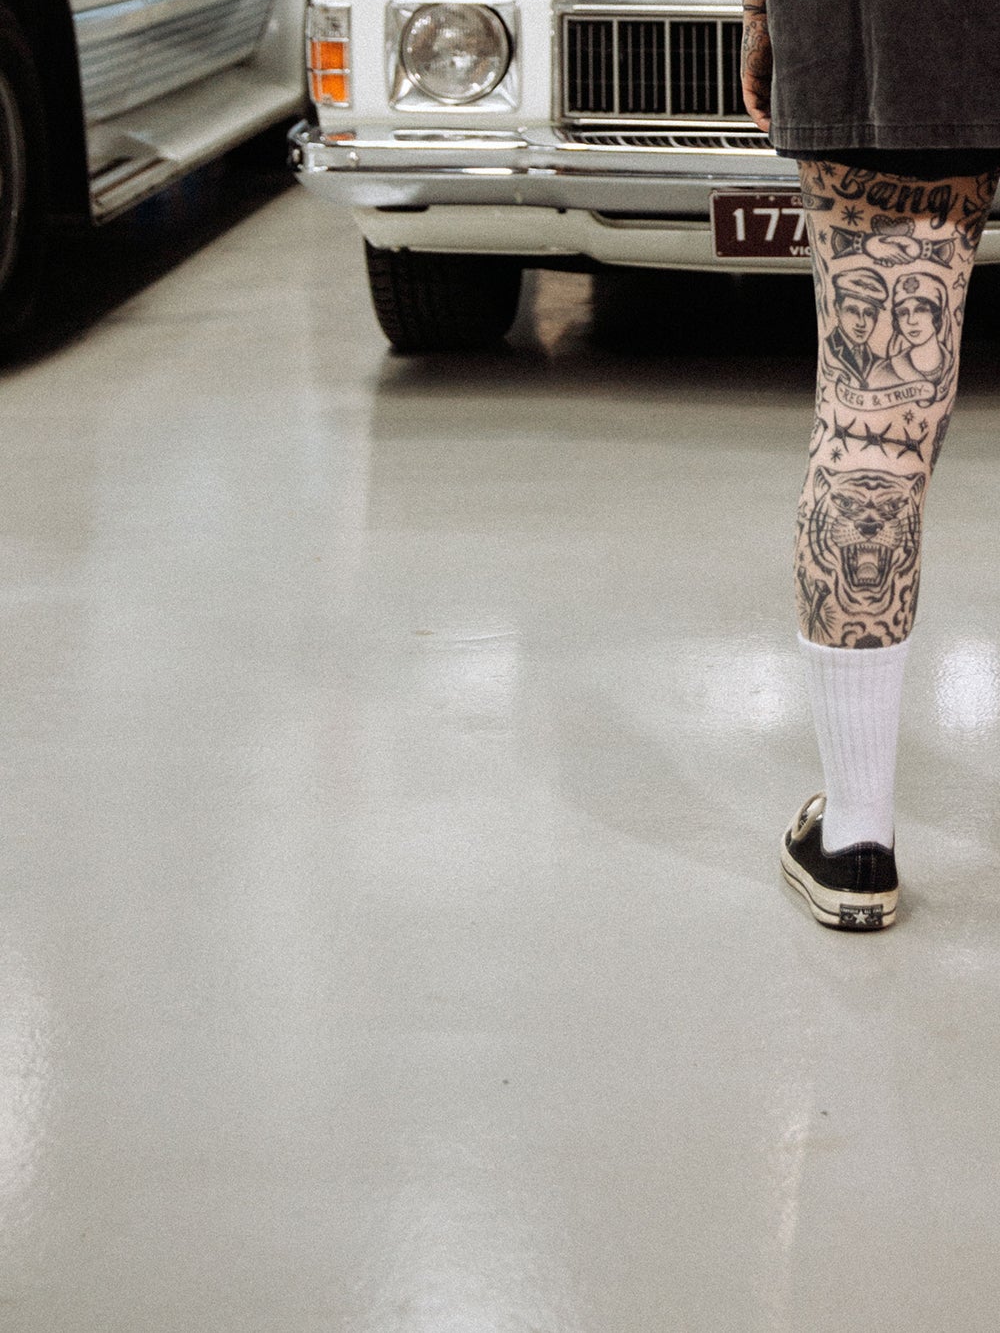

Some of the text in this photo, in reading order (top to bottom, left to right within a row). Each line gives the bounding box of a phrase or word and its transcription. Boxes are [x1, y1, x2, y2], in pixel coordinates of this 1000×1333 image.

[831, 167, 958, 229] Bang
[733, 208, 807, 241] 177
[842, 384, 925, 406] REG & TRUDY
